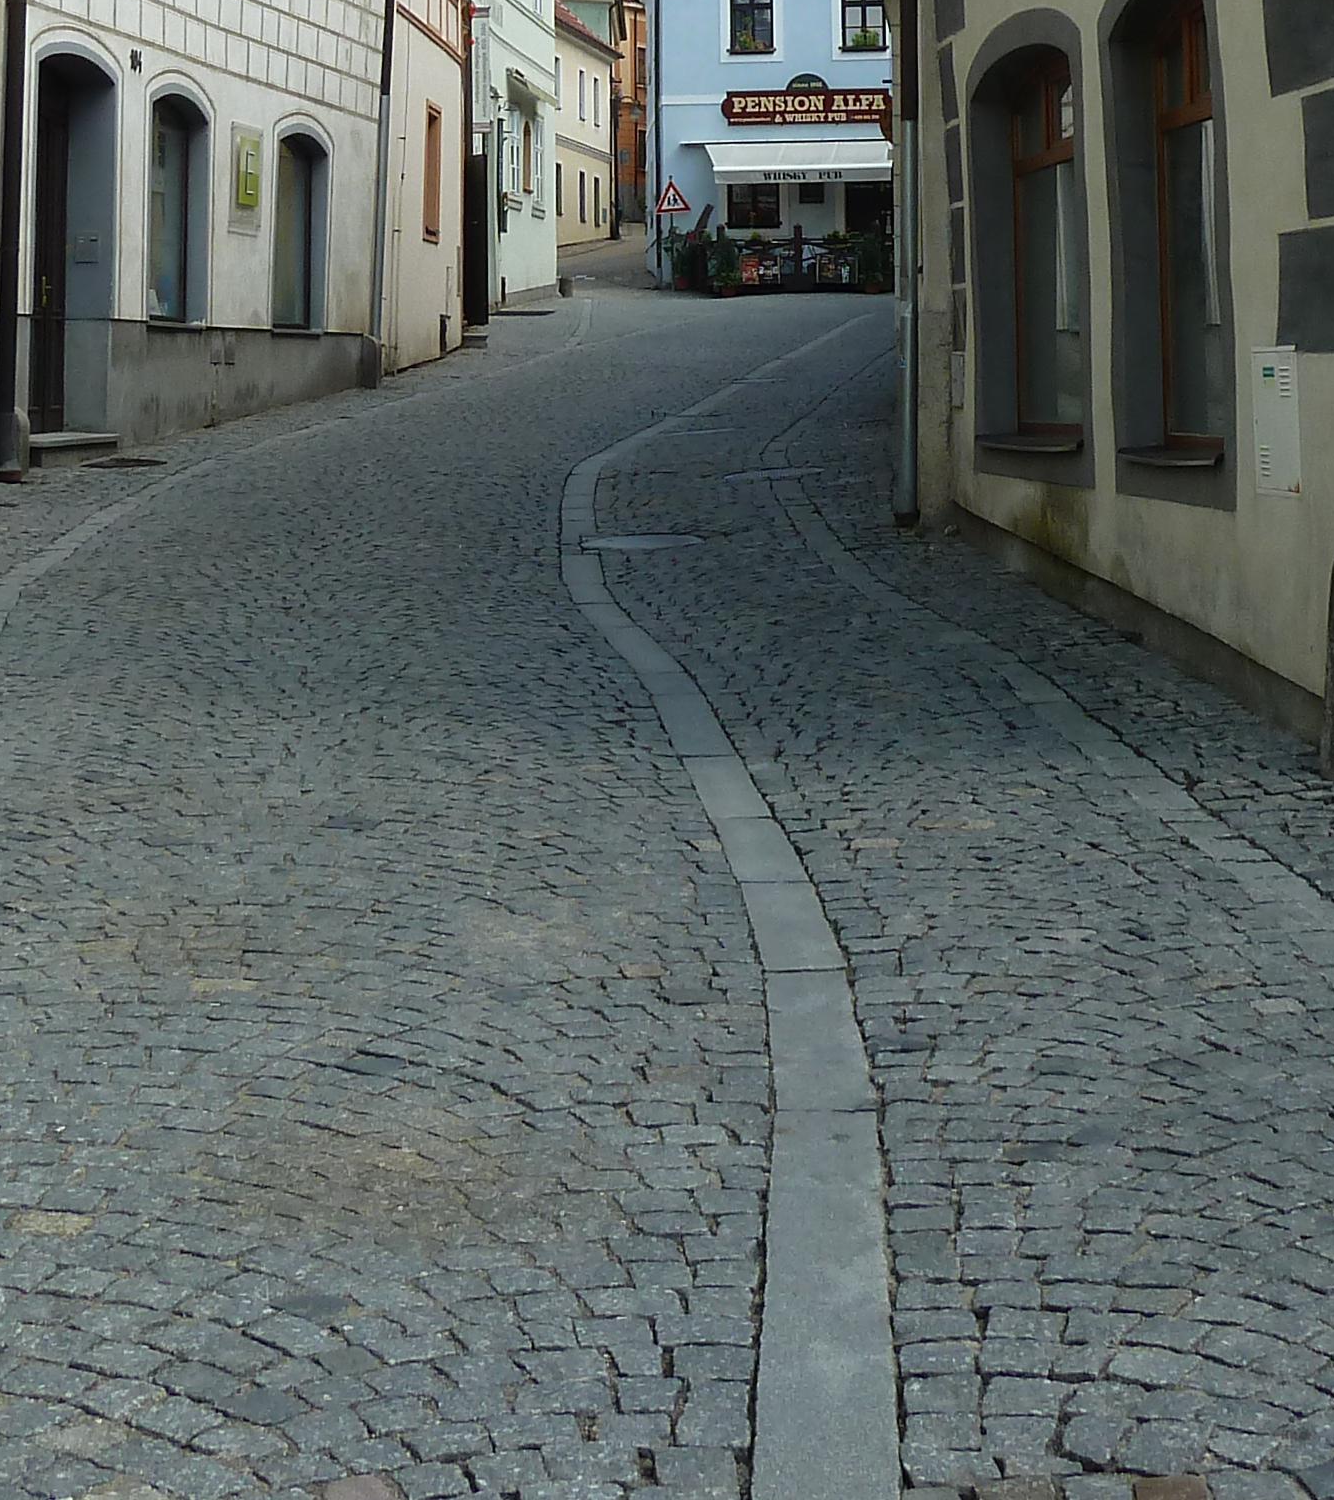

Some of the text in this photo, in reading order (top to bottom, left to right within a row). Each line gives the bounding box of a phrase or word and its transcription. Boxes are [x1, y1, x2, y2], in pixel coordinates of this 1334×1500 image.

[732, 94, 886, 113] PENSION ALFA
[774, 113, 784, 123] &
[785, 112, 827, 123] WHISKY
[828, 111, 847, 122] PUB
[763, 171, 843, 181] WHISKY PUB
